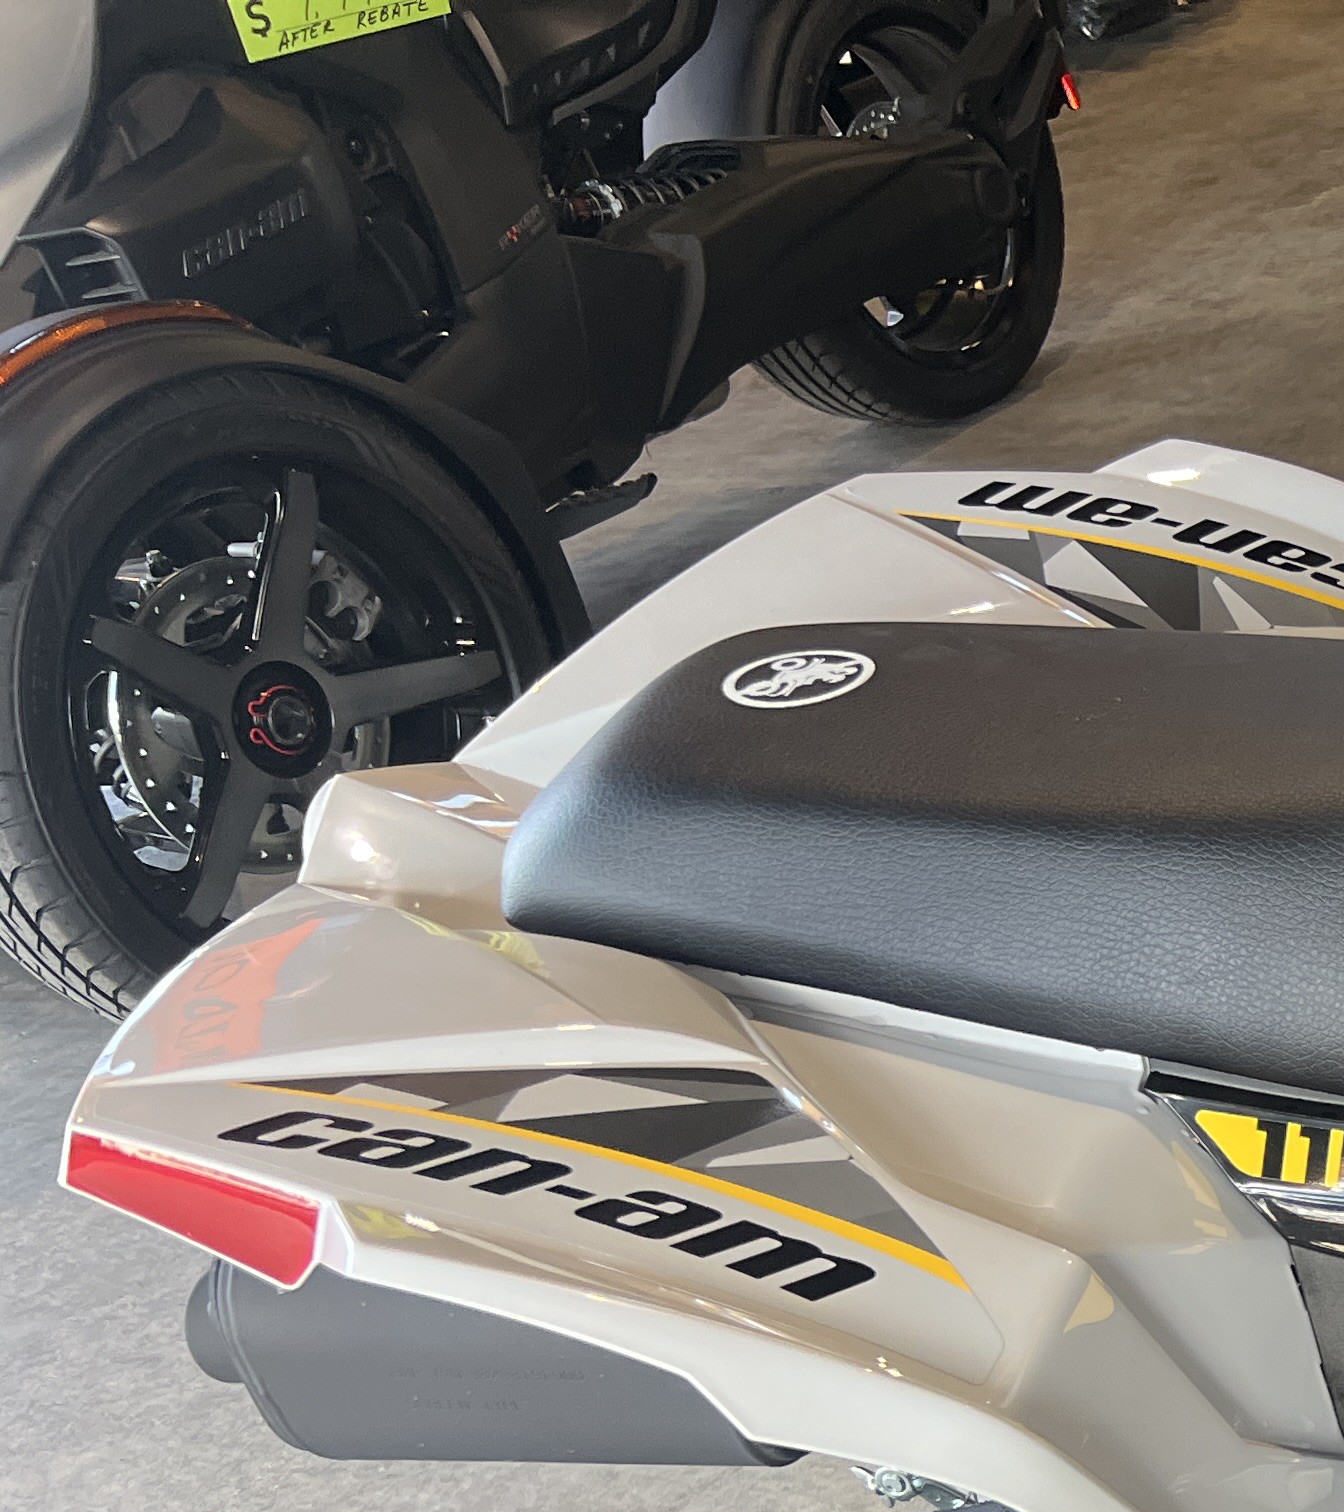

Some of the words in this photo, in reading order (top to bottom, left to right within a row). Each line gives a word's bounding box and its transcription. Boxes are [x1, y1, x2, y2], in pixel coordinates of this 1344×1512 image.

[278, 20, 335, 52] AFTER
[357, 0, 429, 30] REBATE
[217, 1109, 878, 1303] can-am
